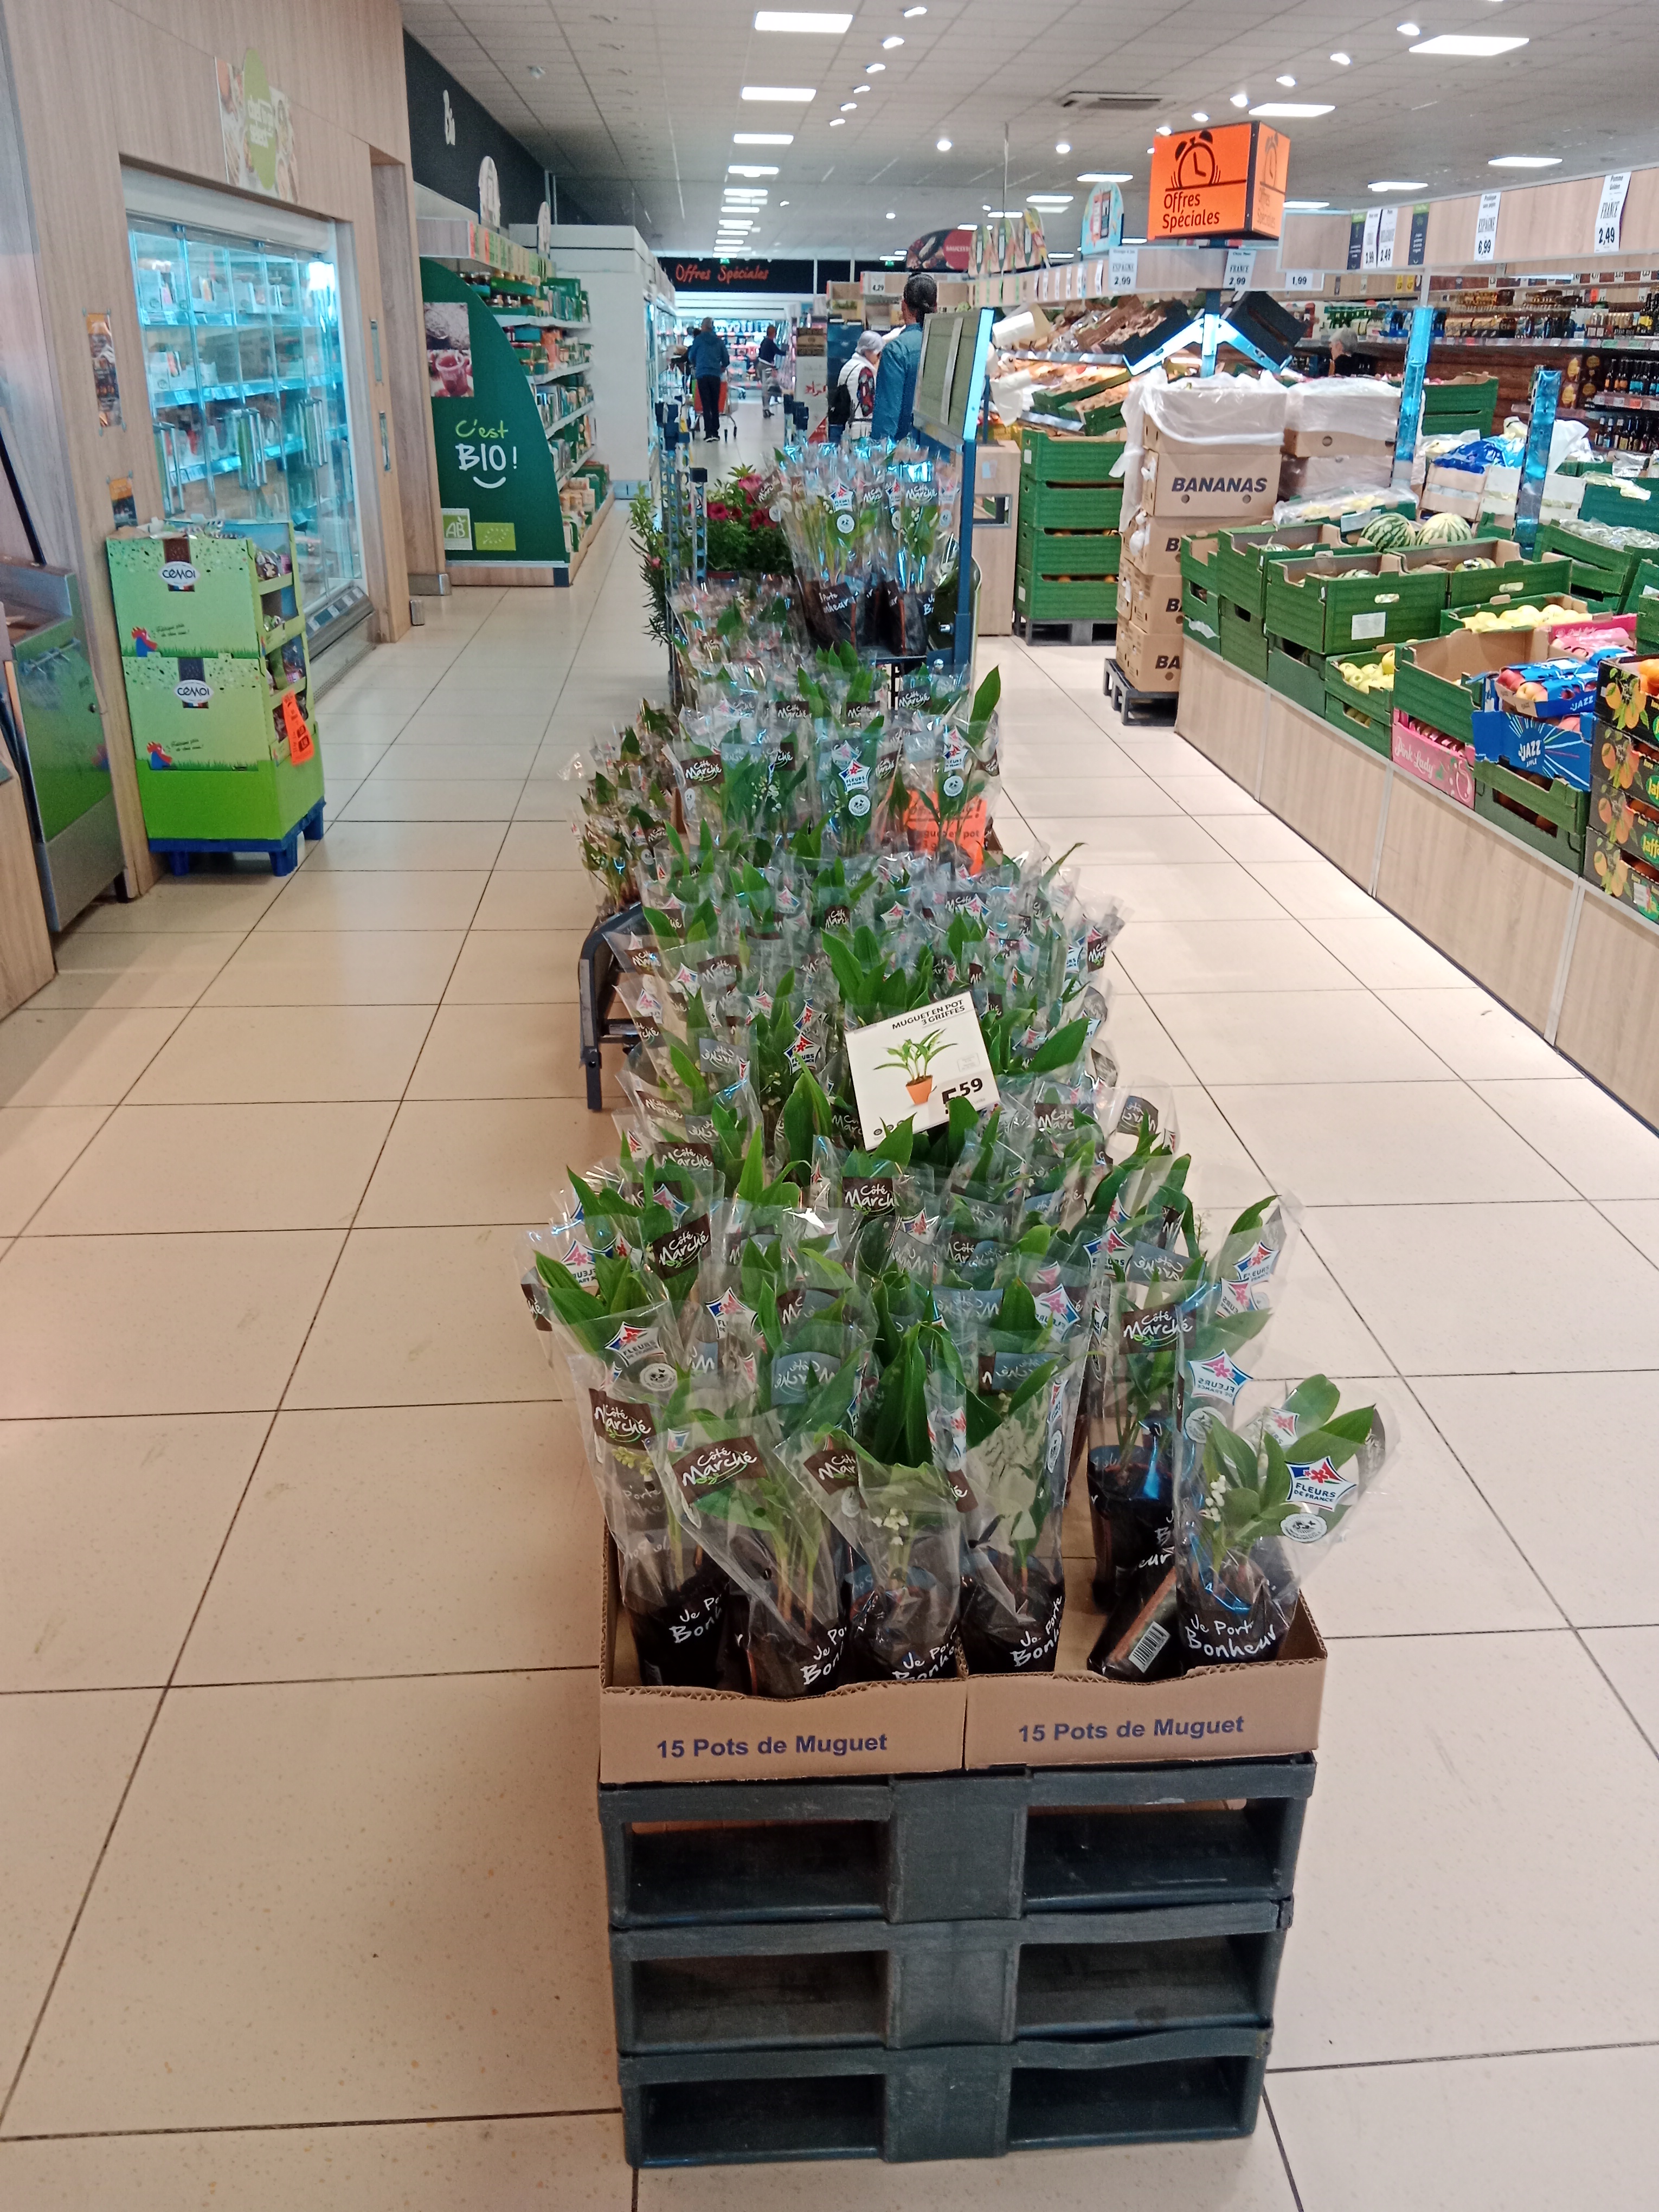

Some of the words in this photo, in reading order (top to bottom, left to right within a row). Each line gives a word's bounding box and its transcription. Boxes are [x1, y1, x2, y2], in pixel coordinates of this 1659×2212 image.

[1163, 191, 1201, 213] Offres
[1600, 201, 1621, 219] FRANCE
[1162, 209, 1220, 233] Spéciales
[1599, 227, 1615, 245] 2,49
[1478, 239, 1491, 255] 6,99
[676, 263, 711, 283] Offres
[717, 265, 769, 284] Spéciales
[1230, 265, 1249, 273] FRANCE
[455, 419, 509, 439] C'est
[1171, 477, 1268, 493] BANANAS
[1570, 695, 1593, 712] JAZZ
[1394, 736, 1414, 763] Pink
[1413, 753, 1435, 778] Lady
[1518, 740, 1542, 761] JAZZ
[685, 764, 722, 779] Marché
[963, 829, 979, 840] pot
[892, 1010, 931, 1030] MUGUET
[931, 1006, 944, 1017] EN
[946, 999, 964, 1012] POT
[928, 1005, 965, 1024] GRIFFES
[792, 1053, 814, 1063] FLURS
[832, 1115, 863, 1135] Marc
[1038, 1114, 1074, 1130] Marc
[673, 1148, 696, 1158] Côté
[860, 1185, 888, 1196] Côté
[659, 1230, 709, 1266] Marché
[668, 1231, 694, 1251] Côté
[1243, 1265, 1270, 1279] FLEURS
[1141, 1310, 1173, 1325] Côté
[1123, 1317, 1193, 1340] Marché
[623, 1339, 656, 1356] FLEURS
[697, 1447, 731, 1465] Côté
[681, 1450, 758, 1487] Marché
[818, 1461, 856, 1481] Mar
[1295, 1482, 1336, 1499] FLEURS
[1304, 1491, 1334, 1503] FRANCE
[679, 1609, 700, 1623] Je
[1187, 1623, 1276, 1658] Bonheur
[813, 1645, 831, 1661] Je
[903, 1651, 925, 1669] Je
[1018, 1725, 1046, 1743] 15
[1053, 1722, 1108, 1741] Pots
[1116, 1720, 1145, 1739] de
[1153, 1715, 1244, 1738] Muguet
[657, 1740, 685, 1759] 15
[692, 1737, 749, 1758] Pots
[757, 1736, 787, 1754] de
[795, 1733, 888, 1757] Muguet
